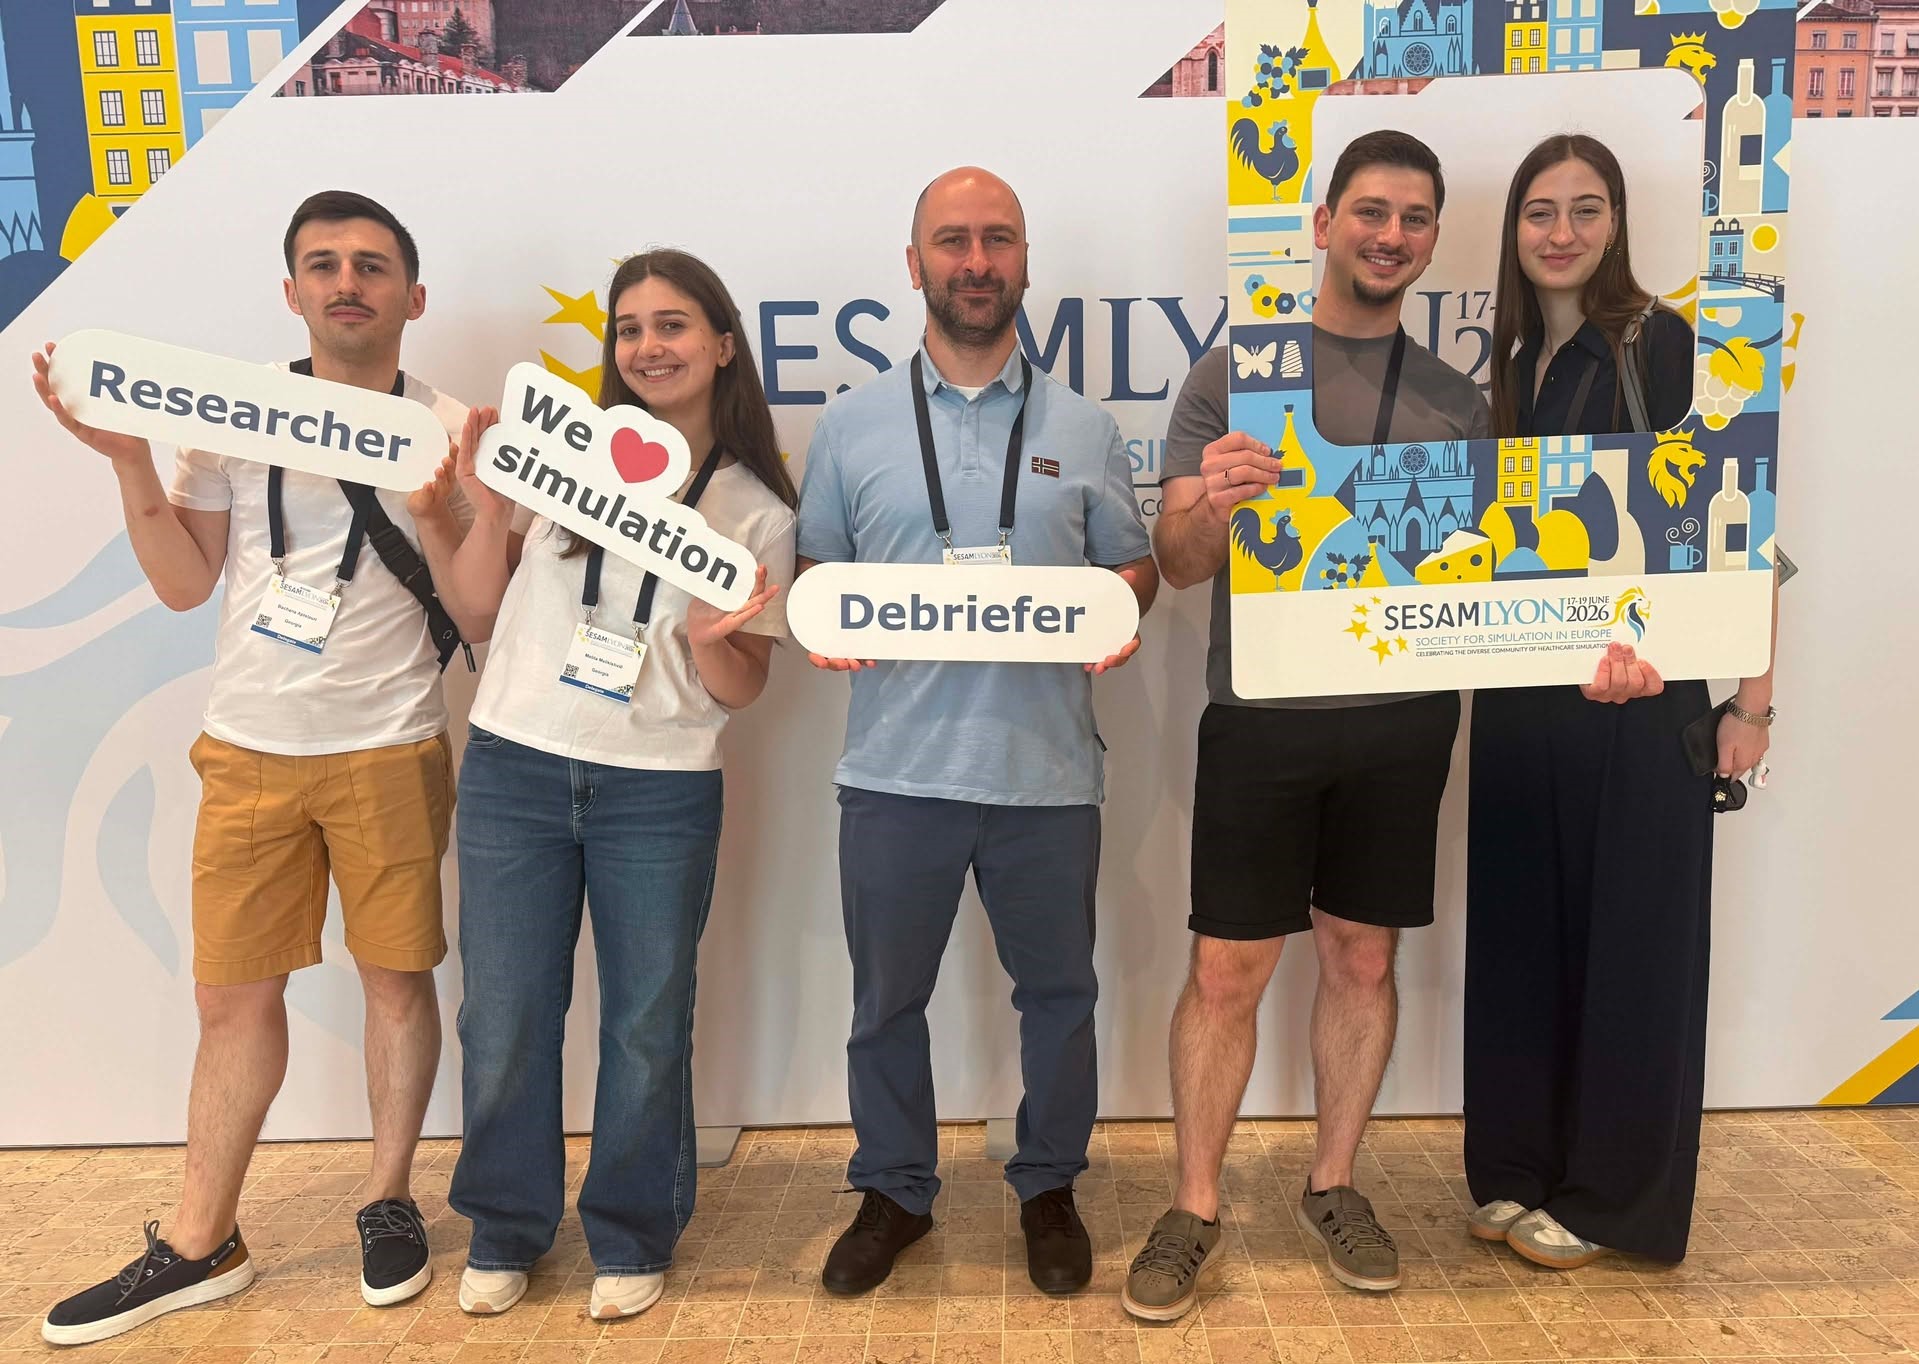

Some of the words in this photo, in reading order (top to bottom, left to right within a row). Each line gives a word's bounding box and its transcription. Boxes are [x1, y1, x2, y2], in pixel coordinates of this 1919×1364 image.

[89, 360, 412, 463] Researcher
[520, 384, 593, 452] We
[492, 443, 739, 591] simulation
[840, 593, 1086, 635] Debriefer
[1384, 598, 1566, 631] SESAMLYON
[1566, 603, 1610, 622] 2026
[1588, 595, 1610, 605] JUNE
[1415, 635, 1461, 647] SOCIETY
[1463, 634, 1485, 645] FOR
[1487, 632, 1554, 644] SIMULATION
[1556, 631, 1568, 640] IN
[1570, 629, 1612, 639] EUROPE
[1415, 650, 1454, 658] CELEBRATING
[1491, 646, 1528, 654] COMMUNITY
[1538, 644, 1575, 652] HEALTHCARE
